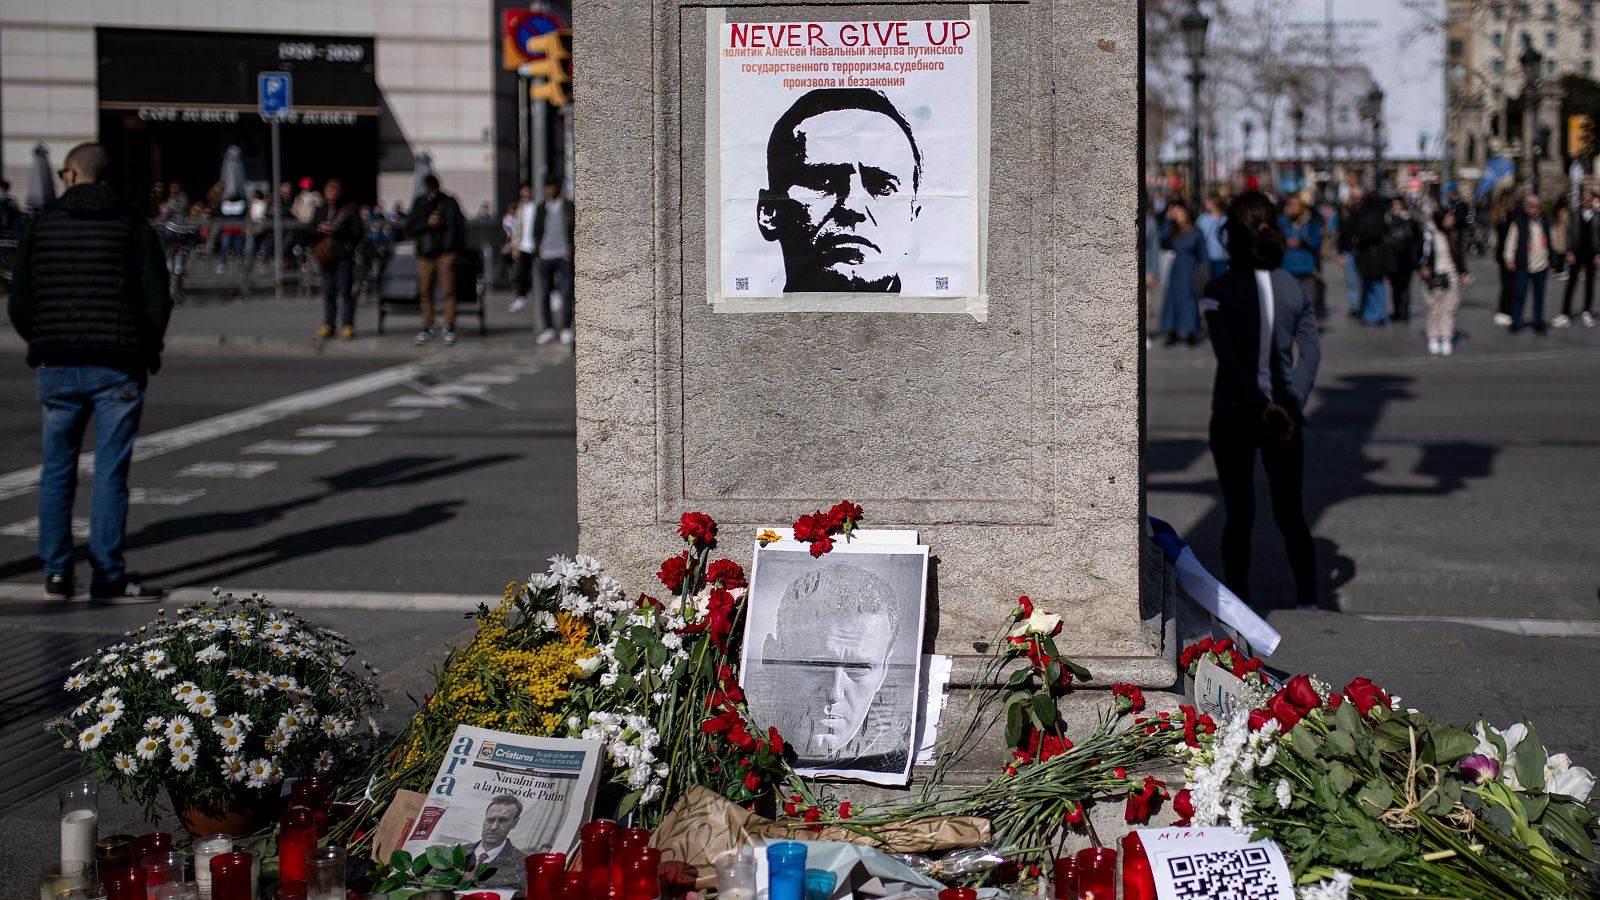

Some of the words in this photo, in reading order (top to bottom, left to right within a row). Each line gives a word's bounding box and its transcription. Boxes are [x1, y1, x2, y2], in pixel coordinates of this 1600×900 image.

[730, 23, 829, 48] NEVER
[839, 22, 910, 47] GIVE
[925, 21, 971, 46] UP
[765, 45, 807, 57] Алексей
[809, 45, 866, 57] Навальный
[868, 46, 905, 59] жертва
[907, 45, 964, 59] путинского
[741, 62, 829, 76] государственного
[783, 77, 836, 91] произвола
[838, 78, 845, 87] и
[847, 75, 906, 88] беззакония
[495, 748, 534, 762] Criatures
[493, 772, 533, 787] Navalni
[534, 780, 556, 790] mor
[473, 782, 481, 790] a
[482, 781, 492, 792] la
[492, 784, 521, 796] presó
[523, 787, 536, 799] de
[537, 789, 564, 801] Putin
